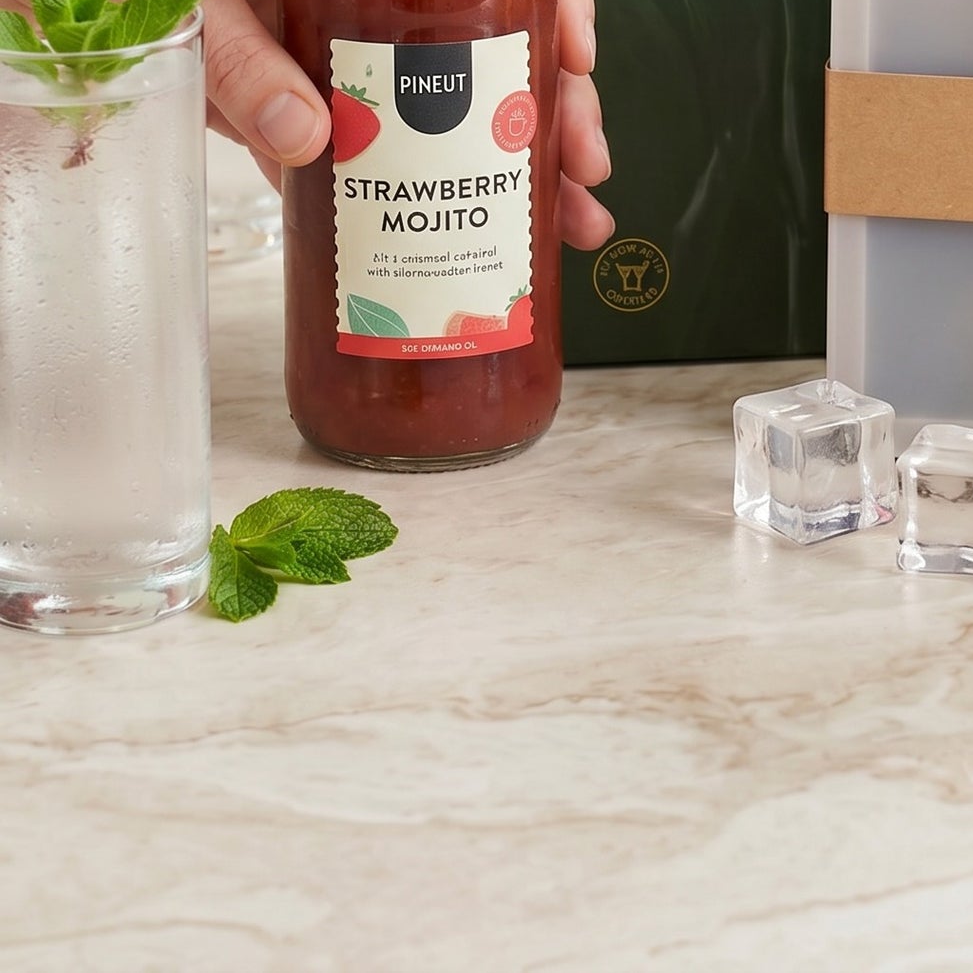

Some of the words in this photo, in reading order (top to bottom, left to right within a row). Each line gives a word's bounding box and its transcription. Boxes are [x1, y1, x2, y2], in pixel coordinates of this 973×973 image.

[400, 73, 466, 95] PINEUT
[344, 169, 522, 202] STRAWBERRY
[381, 207, 489, 233] MOJITO
[367, 267, 390, 277] with
